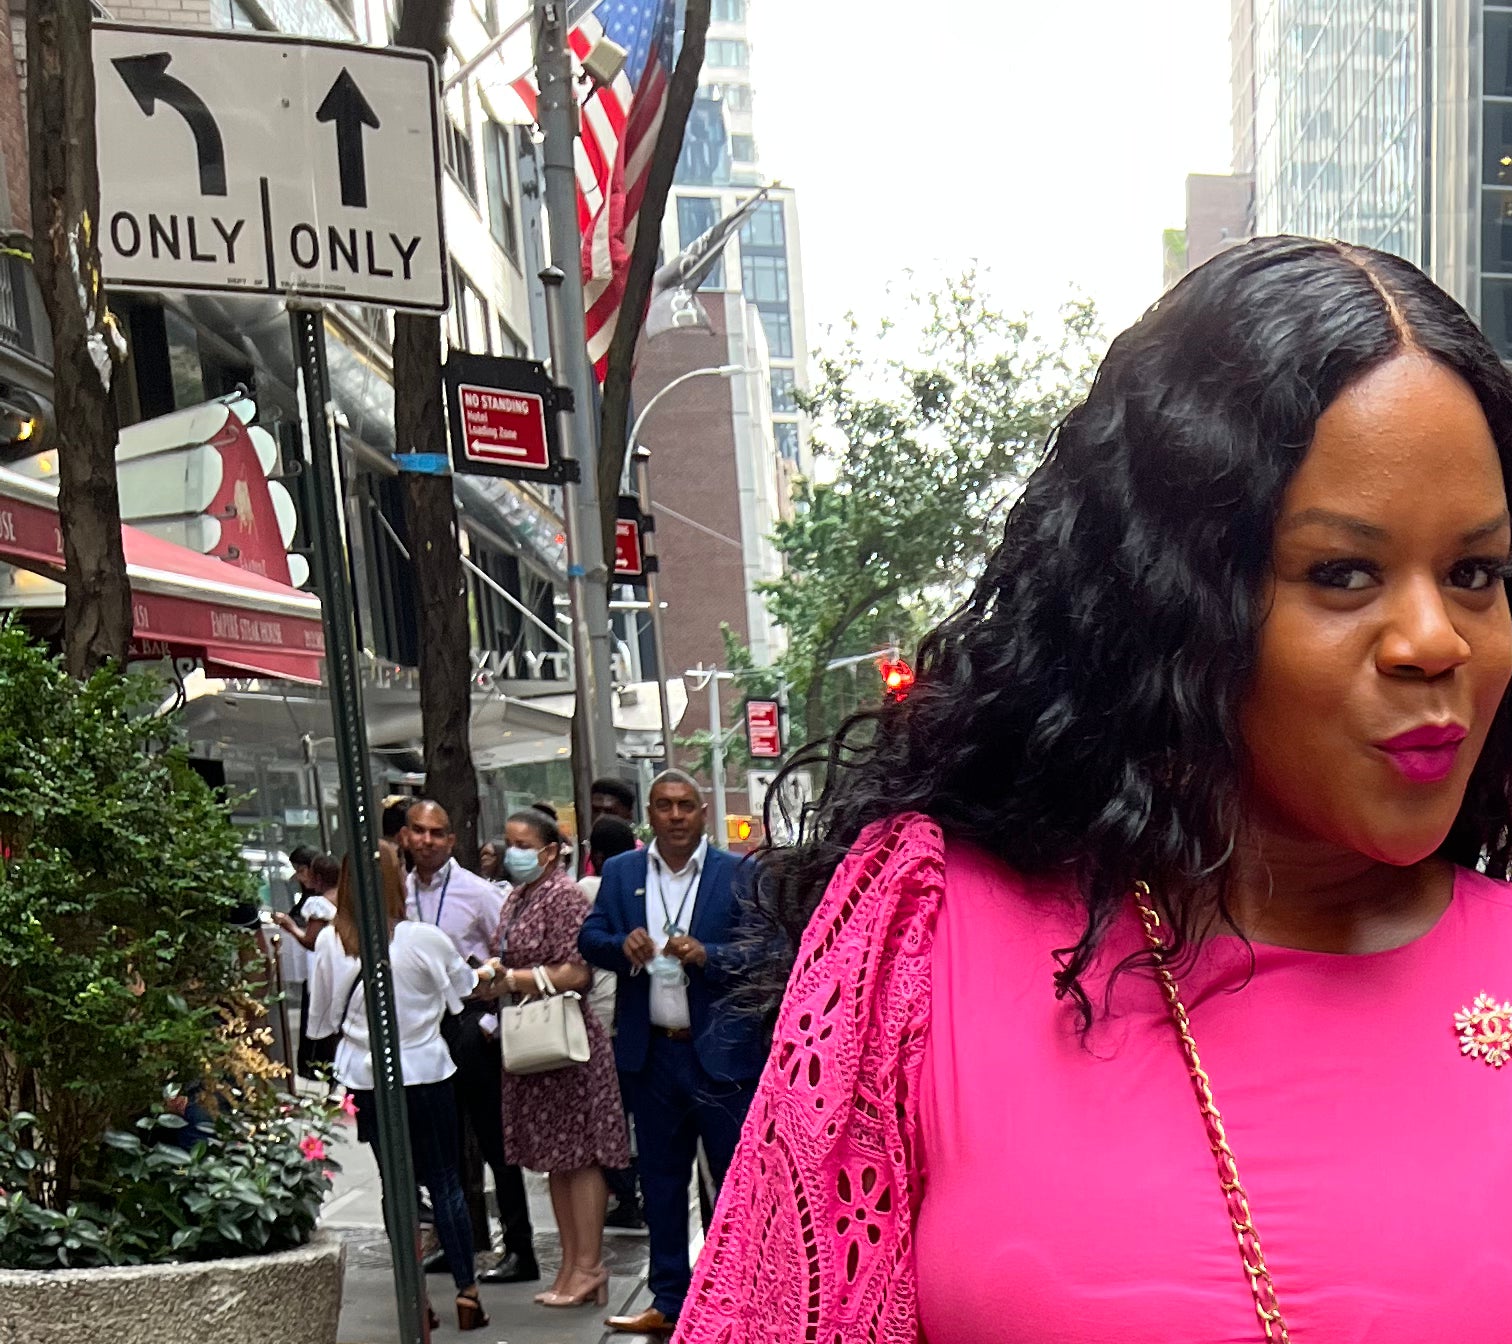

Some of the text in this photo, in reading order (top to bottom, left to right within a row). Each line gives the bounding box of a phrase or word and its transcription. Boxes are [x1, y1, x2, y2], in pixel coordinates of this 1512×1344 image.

[110, 210, 245, 264] ONLY
[290, 222, 422, 280] ONLY
[464, 392, 529, 416] NO STANDING
[142, 639, 171, 656] BAR
